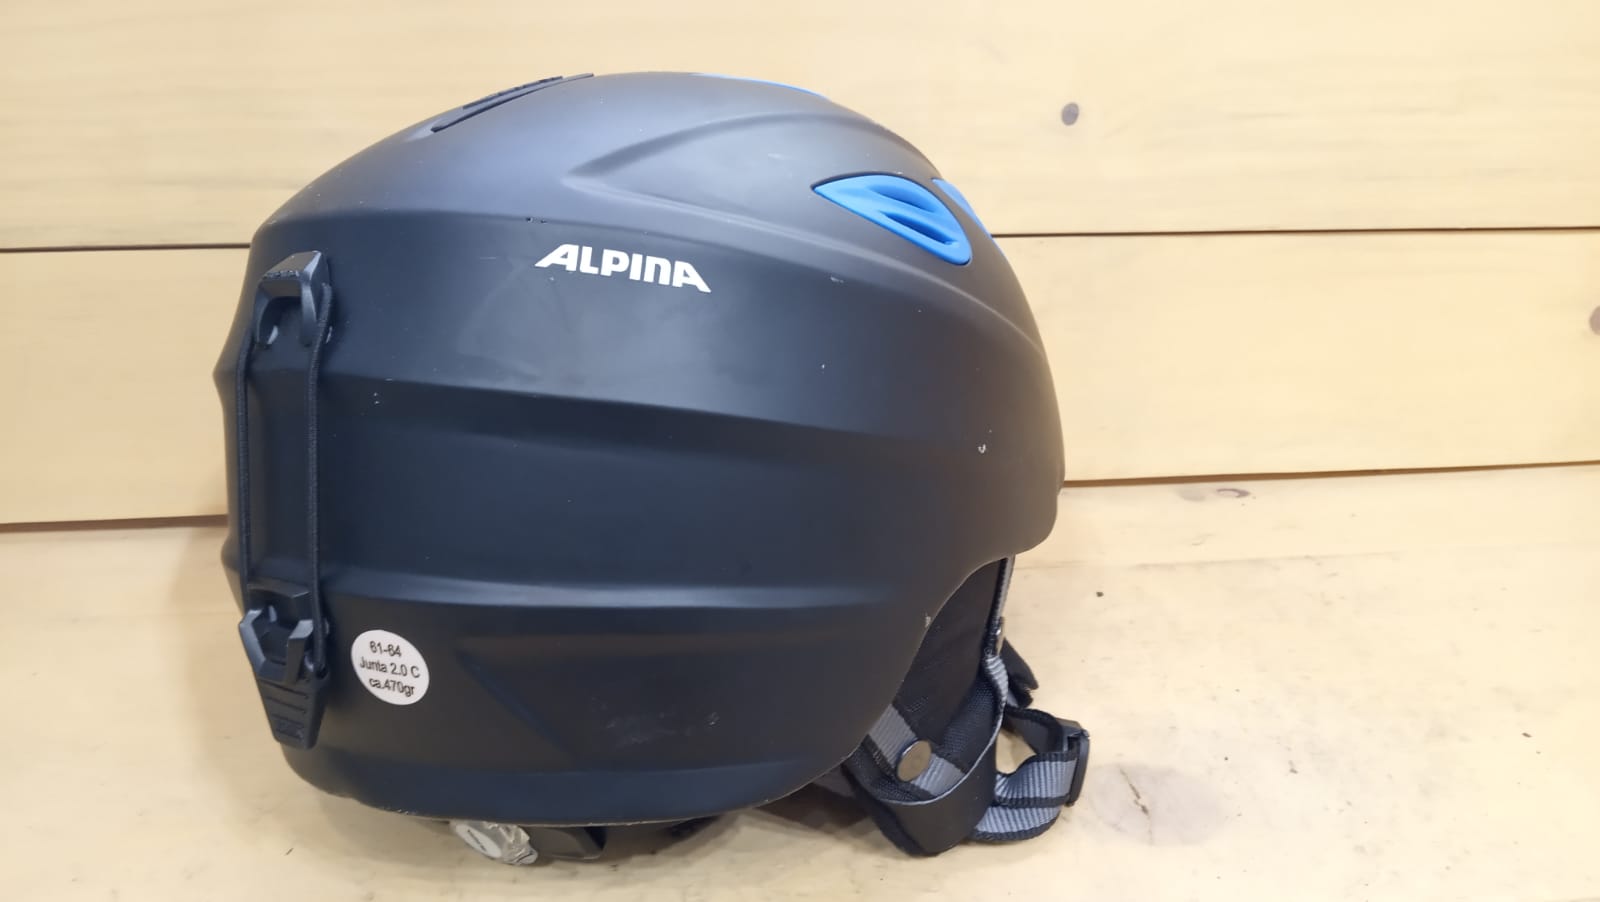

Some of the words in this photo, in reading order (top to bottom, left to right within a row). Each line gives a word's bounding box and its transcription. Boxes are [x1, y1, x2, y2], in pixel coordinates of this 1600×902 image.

[534, 243, 712, 293] ALPINA
[369, 640, 402, 658] 61-64
[390, 662, 408, 677] 2.0
[410, 665, 421, 679] C
